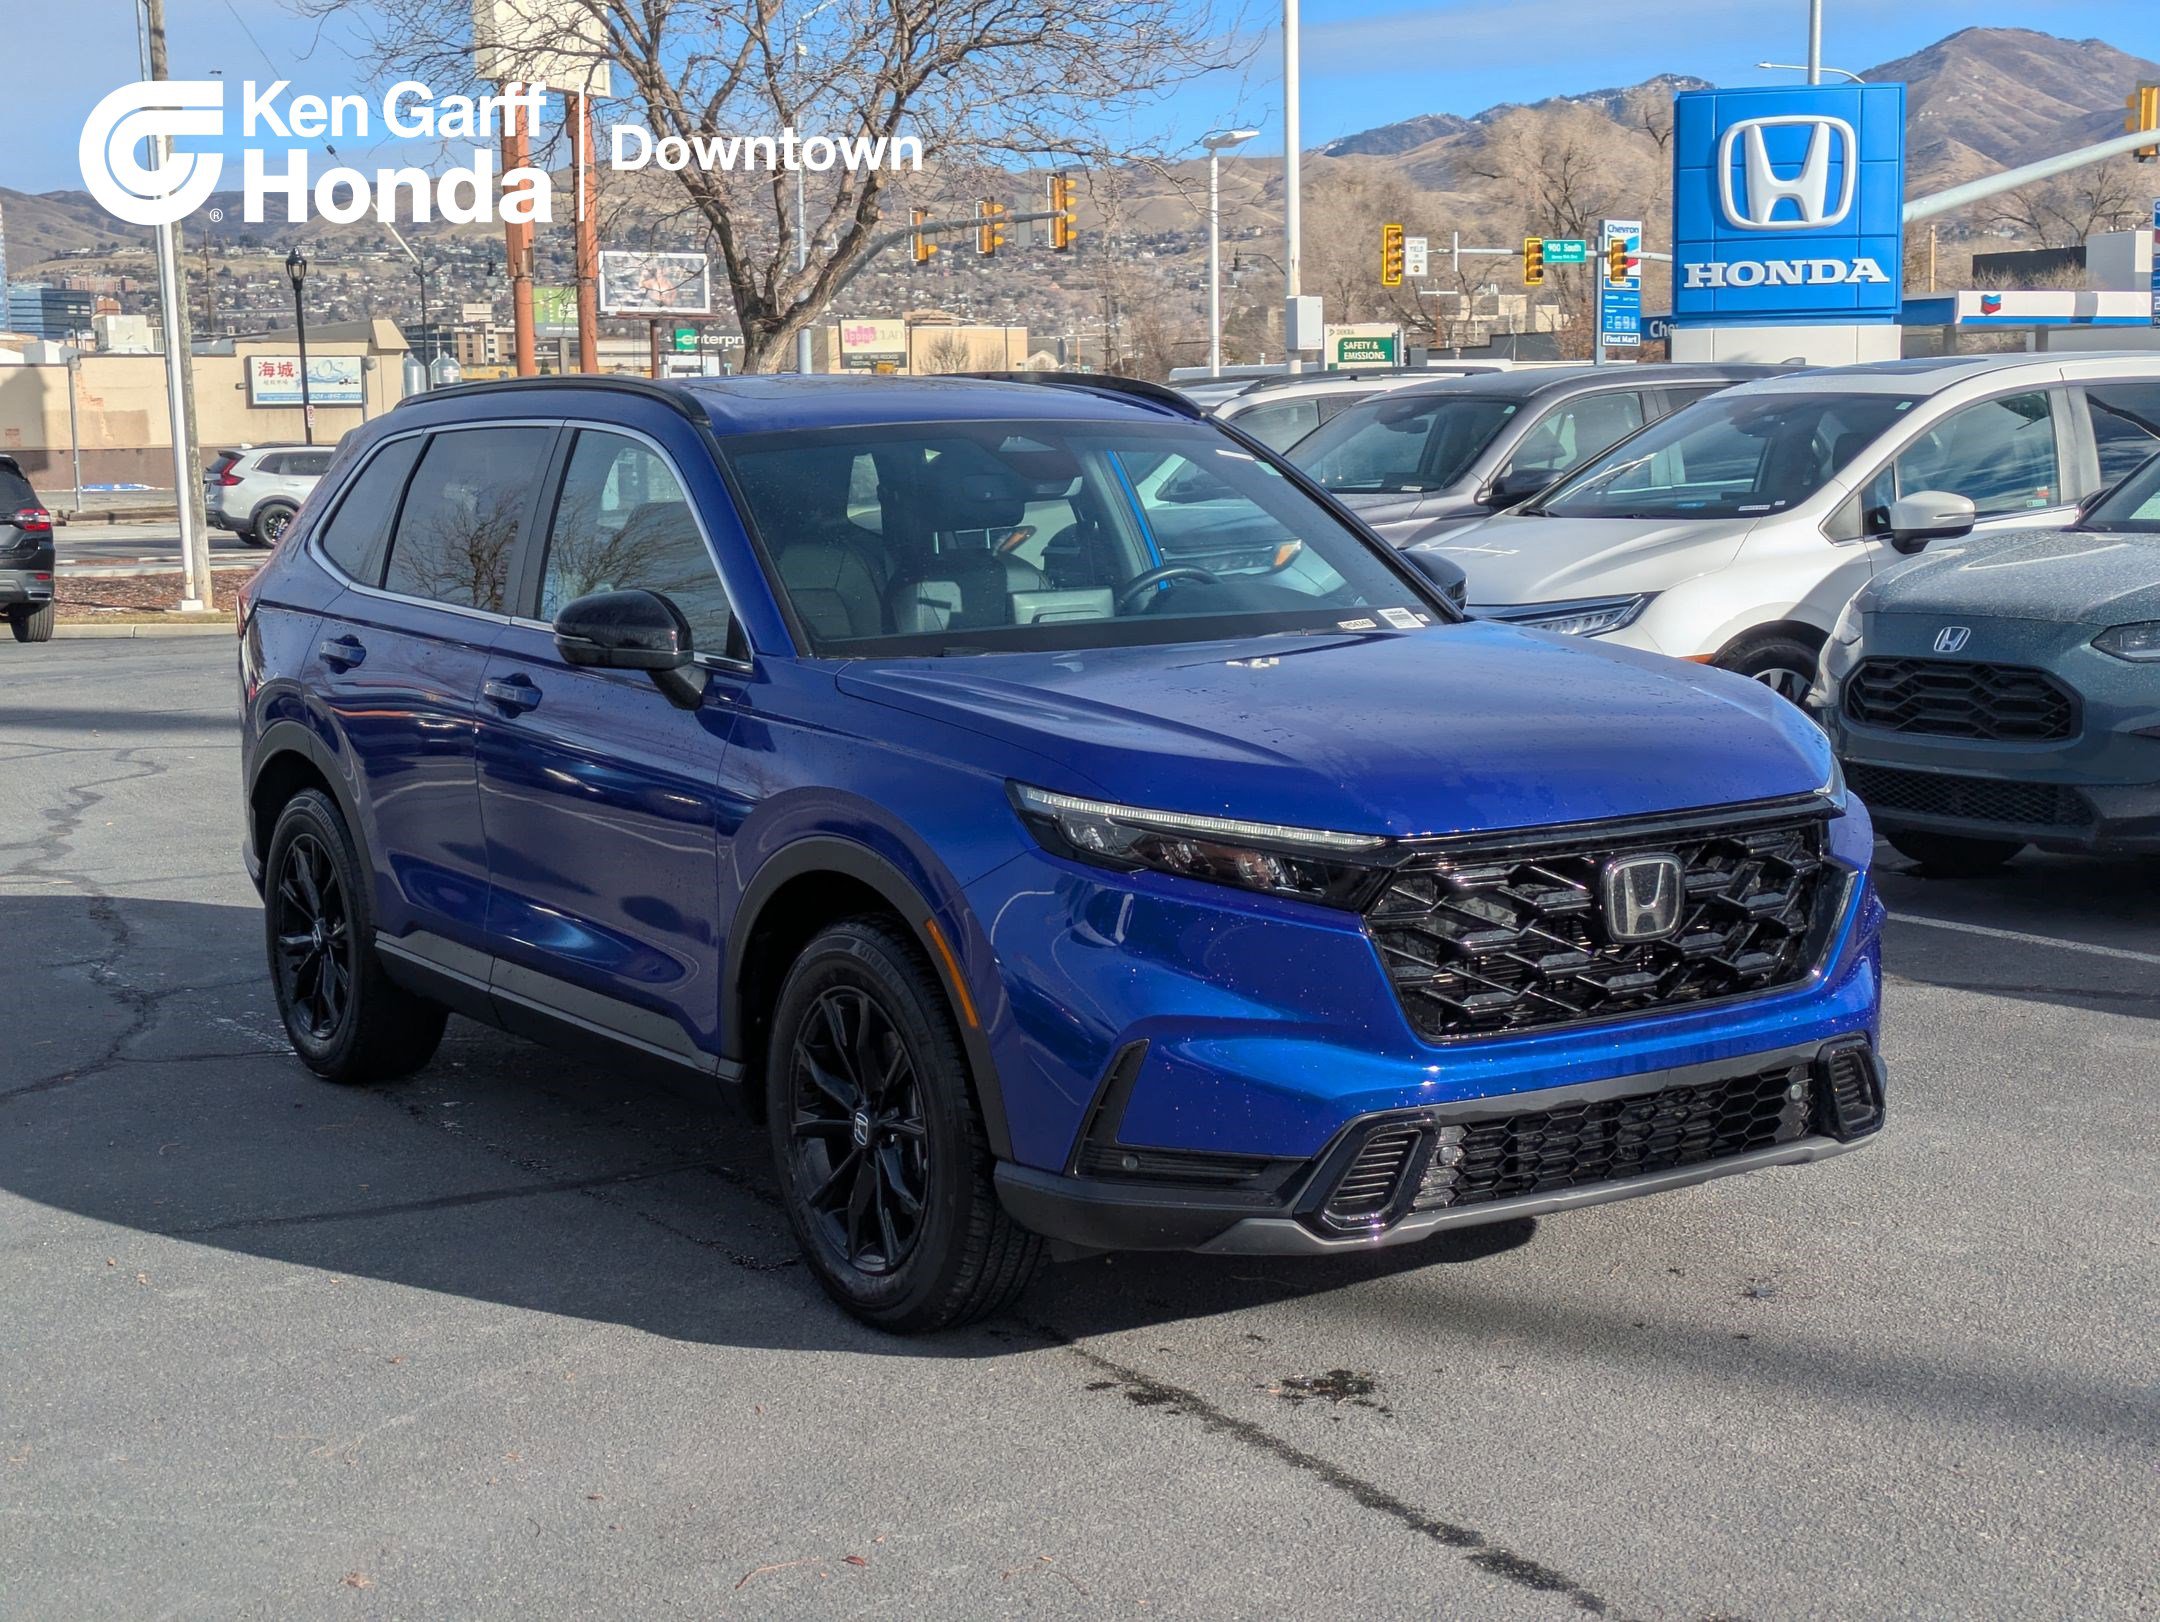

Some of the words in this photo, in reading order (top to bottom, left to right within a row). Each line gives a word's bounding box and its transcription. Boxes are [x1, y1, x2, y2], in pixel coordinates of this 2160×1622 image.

[1607, 224, 1639, 233] Chevron
[1563, 243, 1582, 252] South
[1683, 258, 1890, 288] HONDA
[677, 333, 745, 347] enterpri
[1605, 334, 1623, 343] Food
[1624, 335, 1638, 343] Mart
[1343, 341, 1371, 350] SAFETY
[1372, 341, 1379, 350] &
[1343, 351, 1386, 360] EMISSIONS
